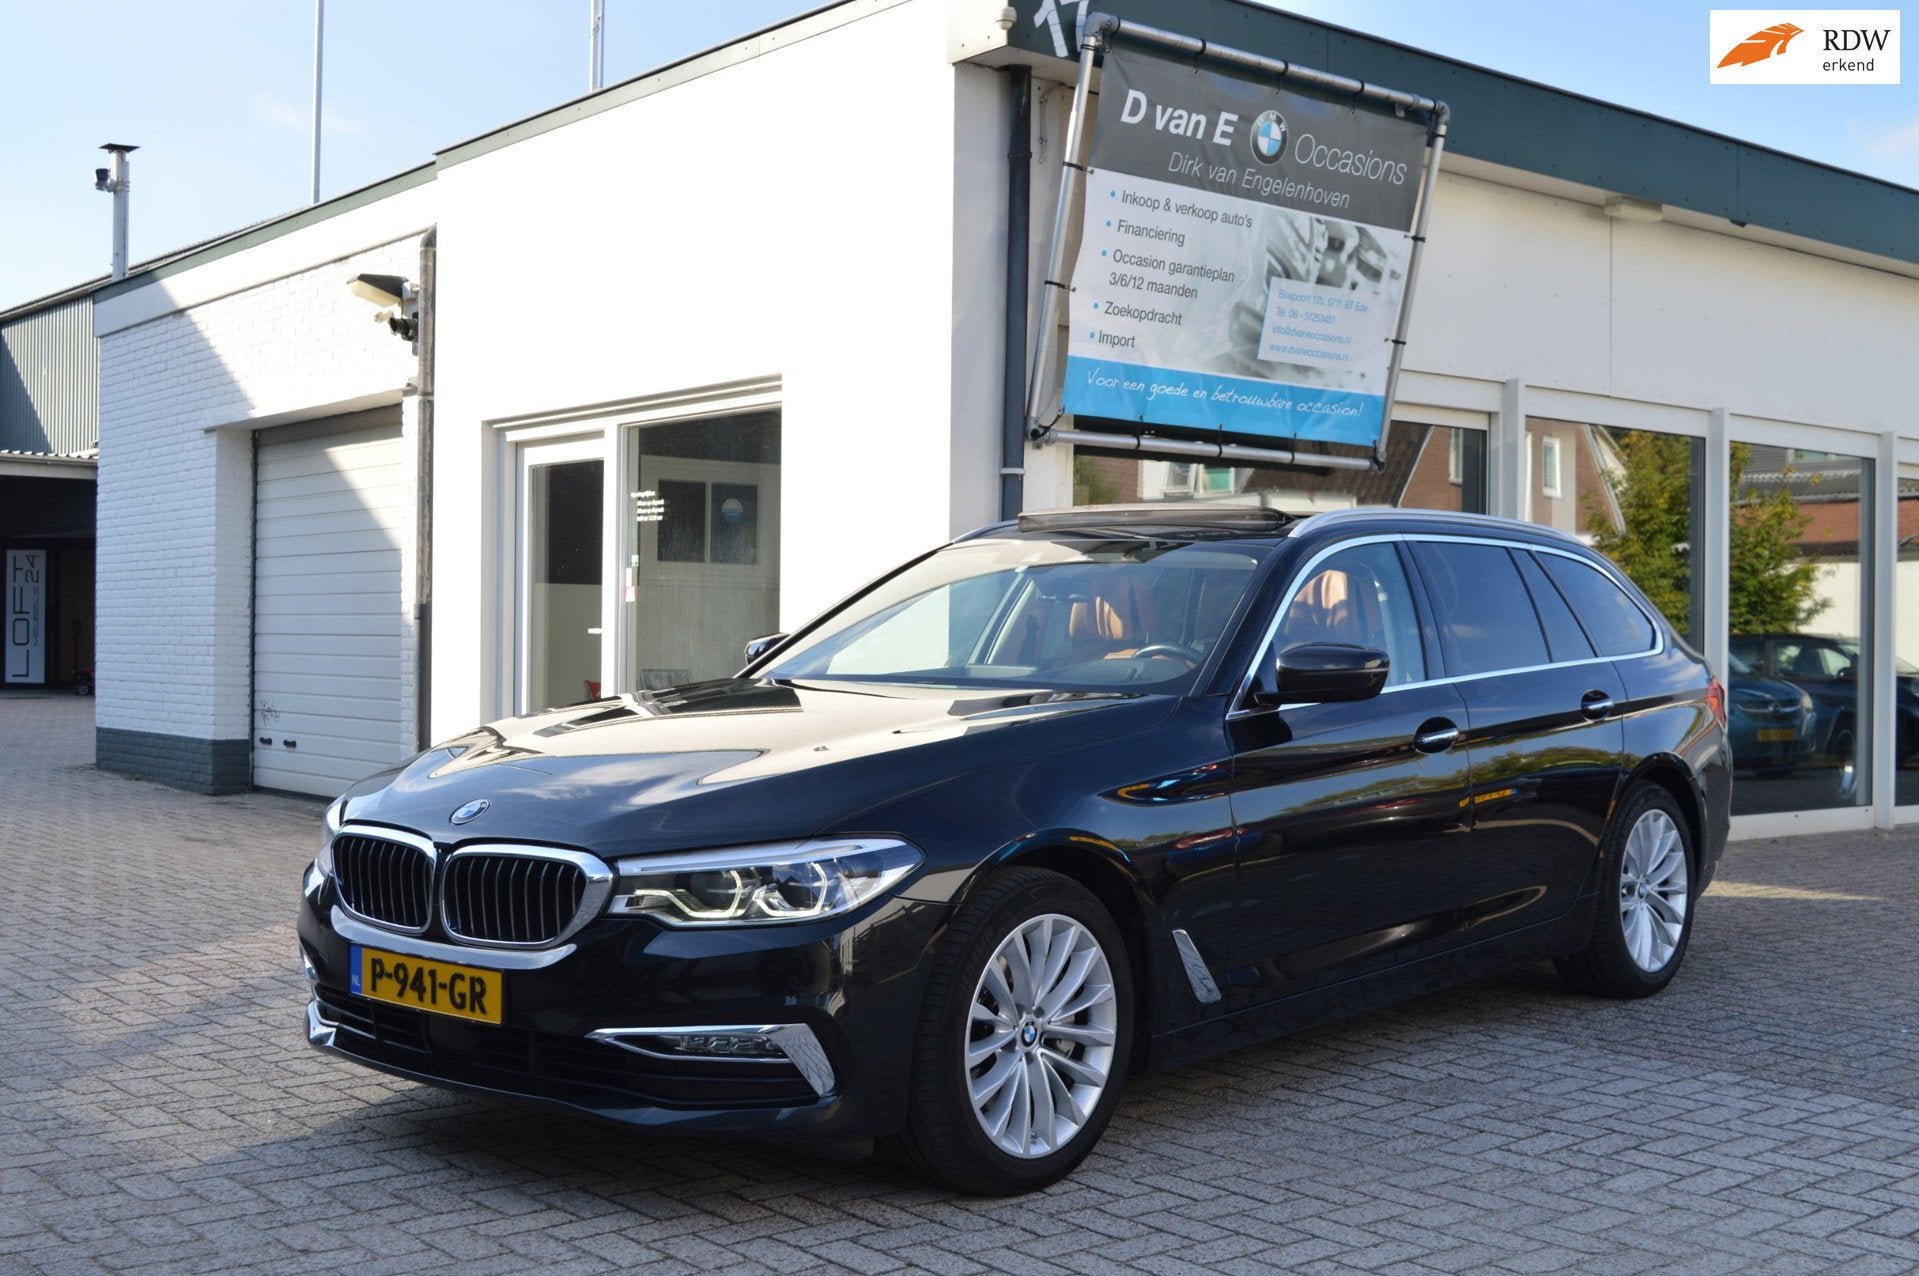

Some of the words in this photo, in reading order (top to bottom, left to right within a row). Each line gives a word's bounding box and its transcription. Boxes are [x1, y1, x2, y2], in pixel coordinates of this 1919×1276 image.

[1120, 89, 1147, 124] D
[1155, 104, 1207, 139] van
[1212, 111, 1239, 146] E
[1295, 133, 1407, 185] Occasions
[1168, 151, 1203, 177] Dirk
[1208, 164, 1237, 185] van
[1241, 168, 1350, 208] Engelenhoven
[1121, 190, 1160, 212] Inkoop
[1163, 198, 1171, 212] &
[1175, 203, 1219, 223] verkoop
[1221, 211, 1253, 228] auto's
[1117, 219, 1185, 247] Financiering
[1113, 248, 1166, 270] Occasion
[1168, 262, 1235, 283] garantieplan
[1109, 272, 1144, 290] 3/6/12
[1146, 280, 1198, 299] maanden
[1104, 301, 1182, 325] Zoekopdracht
[1098, 330, 1136, 348] Import
[1087, 367, 1119, 388] Voor
[1122, 380, 1145, 392] een
[1146, 382, 1188, 400] goede
[1193, 389, 1206, 400] en
[1211, 384, 1292, 411] betrouwbare
[1297, 402, 1363, 417] occasion!
[25, 555, 39, 583] 24
[12, 555, 30, 677] LOFT
[351, 974, 361, 986] NL
[370, 958, 487, 1015] P-941-GR
